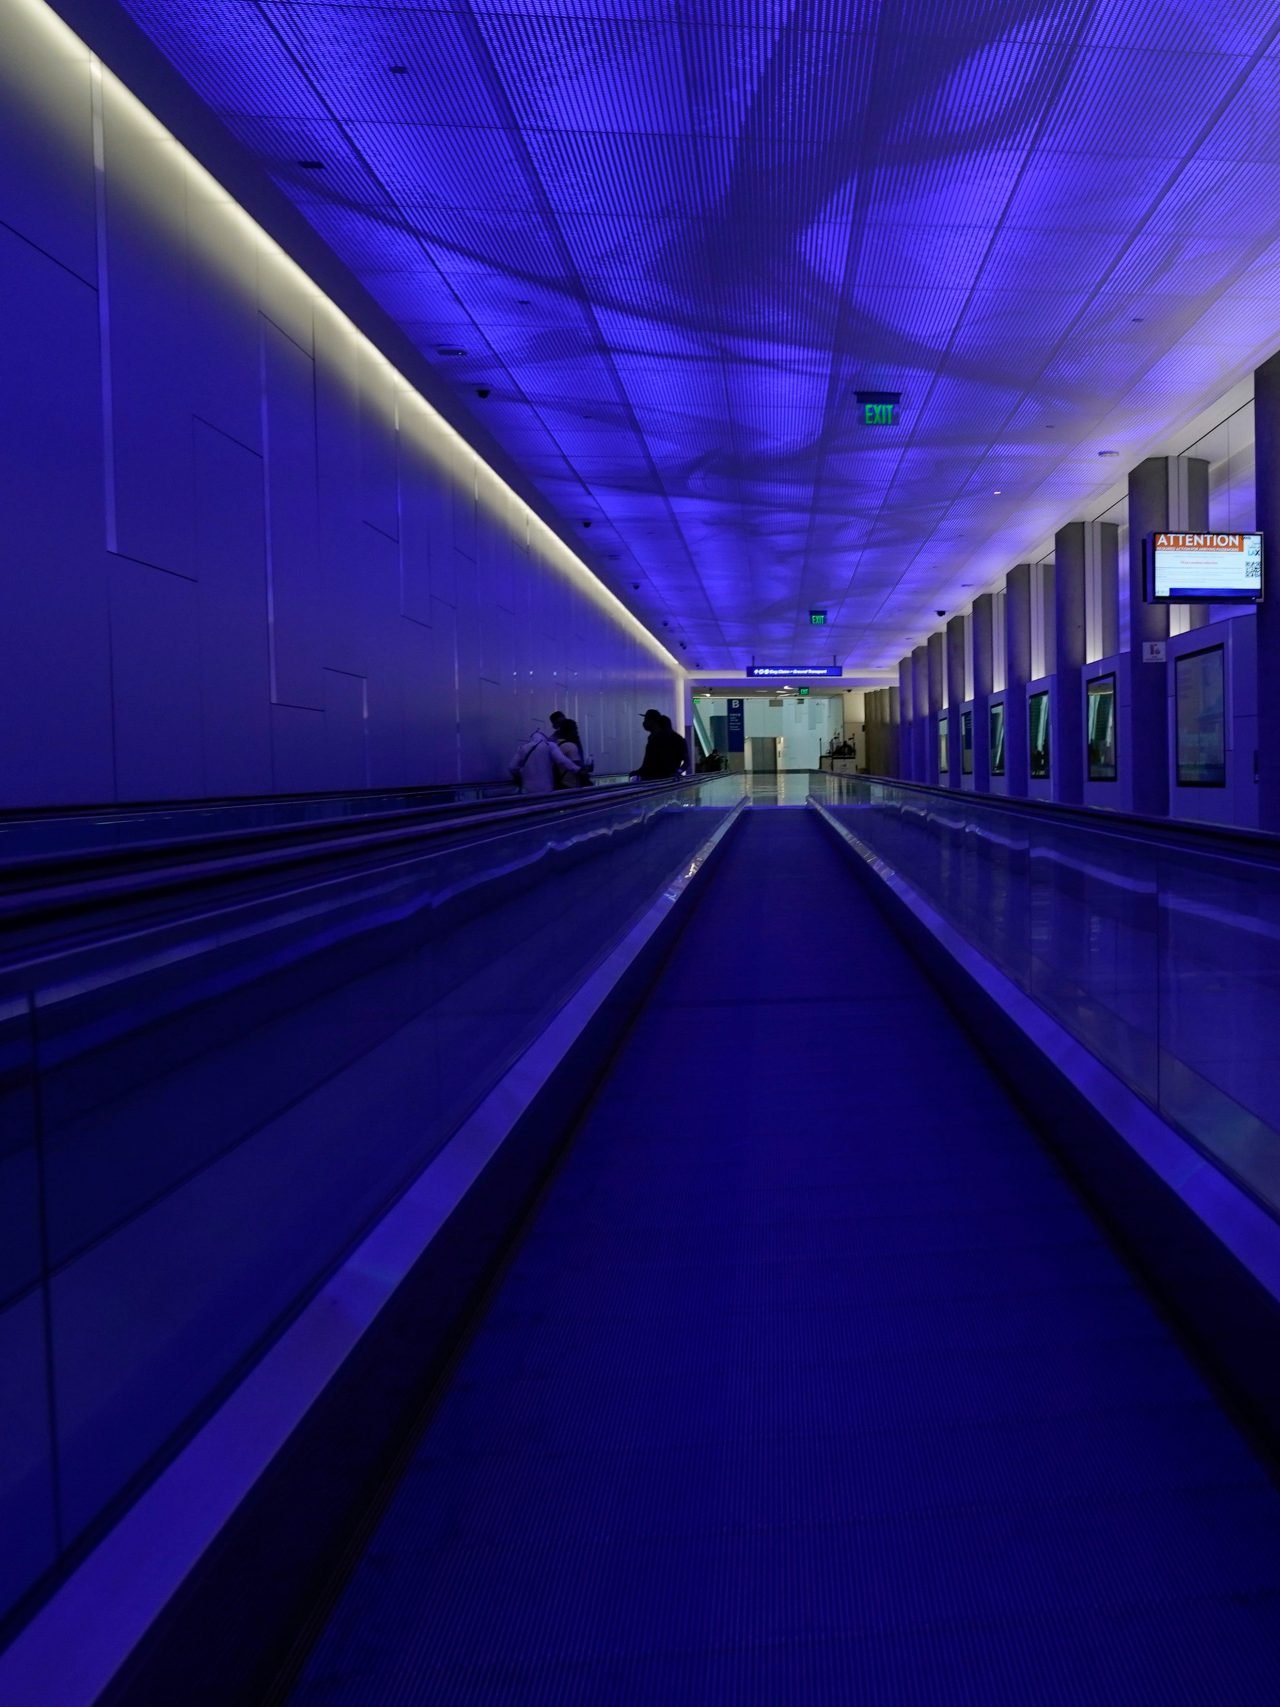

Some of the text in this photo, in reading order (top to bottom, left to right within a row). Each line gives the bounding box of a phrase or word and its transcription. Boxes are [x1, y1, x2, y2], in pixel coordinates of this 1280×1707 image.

[865, 404, 894, 425] EXIT
[1156, 533, 1240, 547] ATTENTION
[731, 699, 740, 709] B
